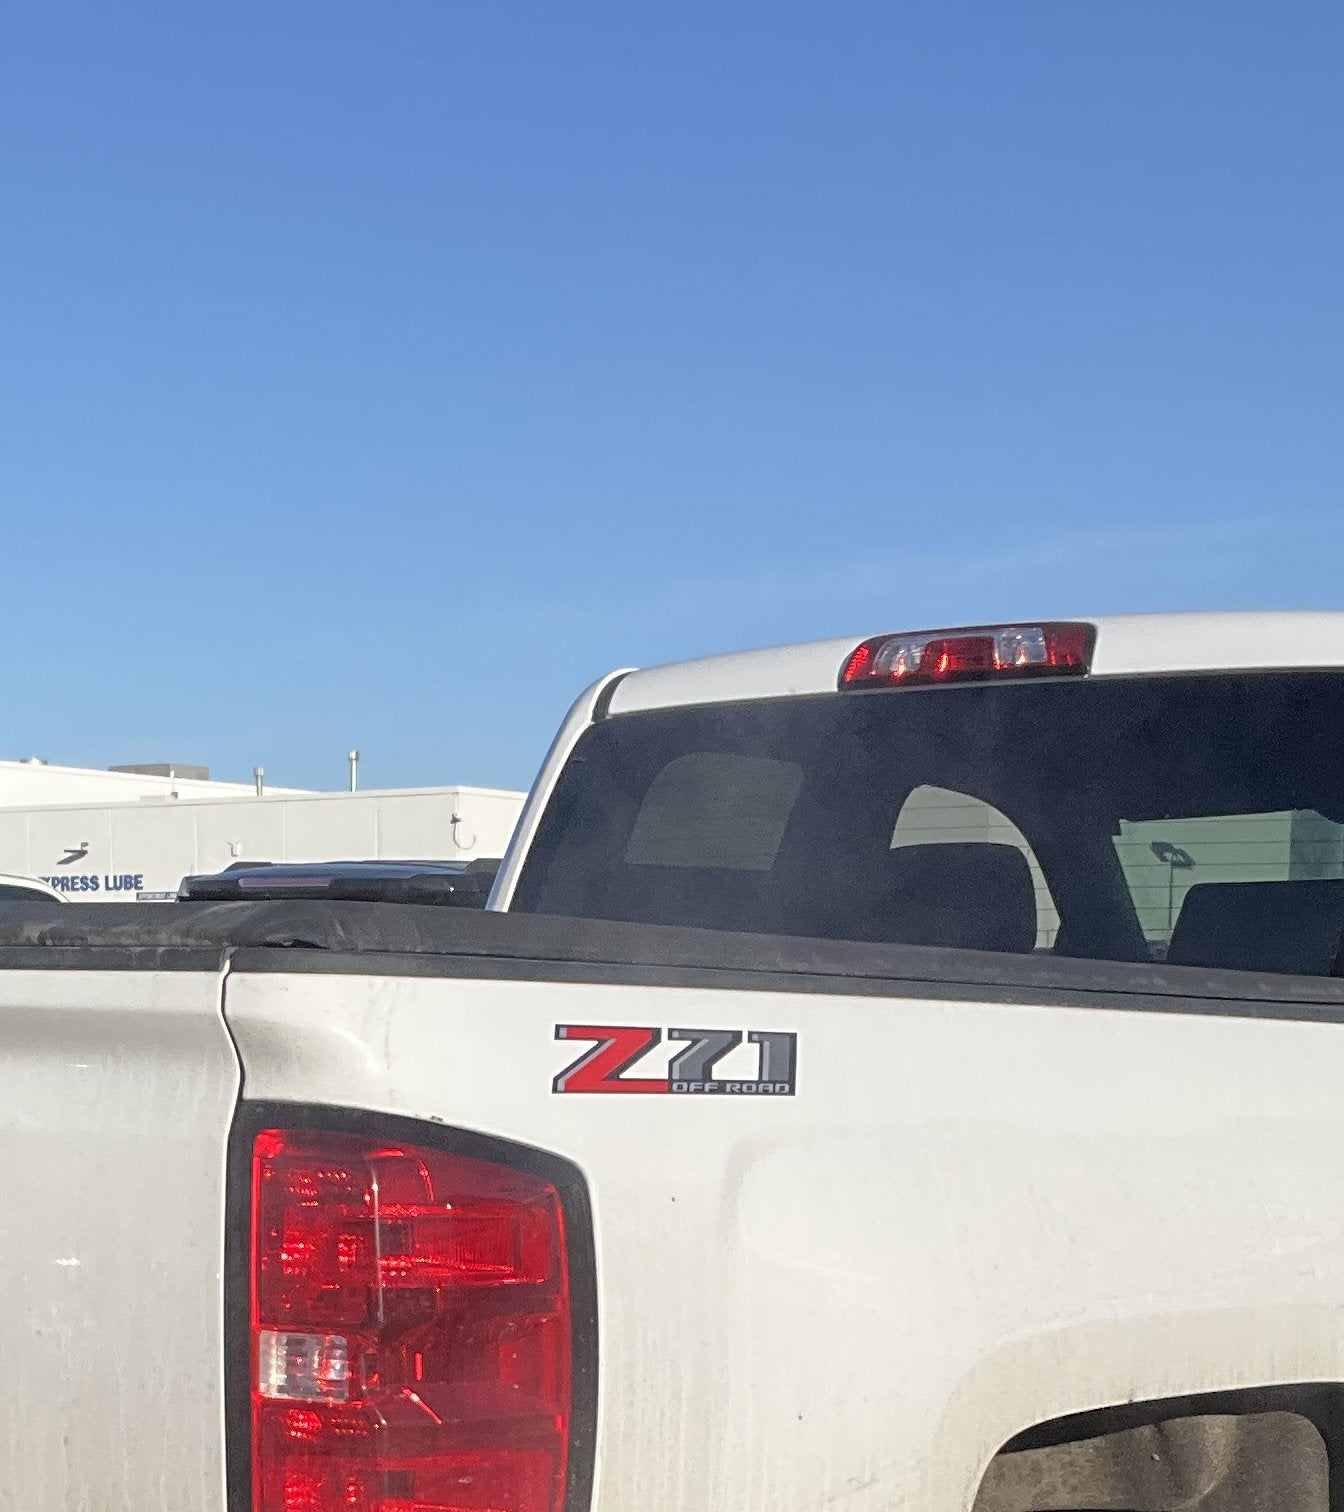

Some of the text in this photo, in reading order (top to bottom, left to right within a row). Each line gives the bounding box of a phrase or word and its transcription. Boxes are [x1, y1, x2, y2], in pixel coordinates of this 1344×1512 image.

[39, 874, 144, 892] PRESS LUBE
[552, 1024, 797, 1096] Z71
[672, 1081, 790, 1094] OFF ROAD
